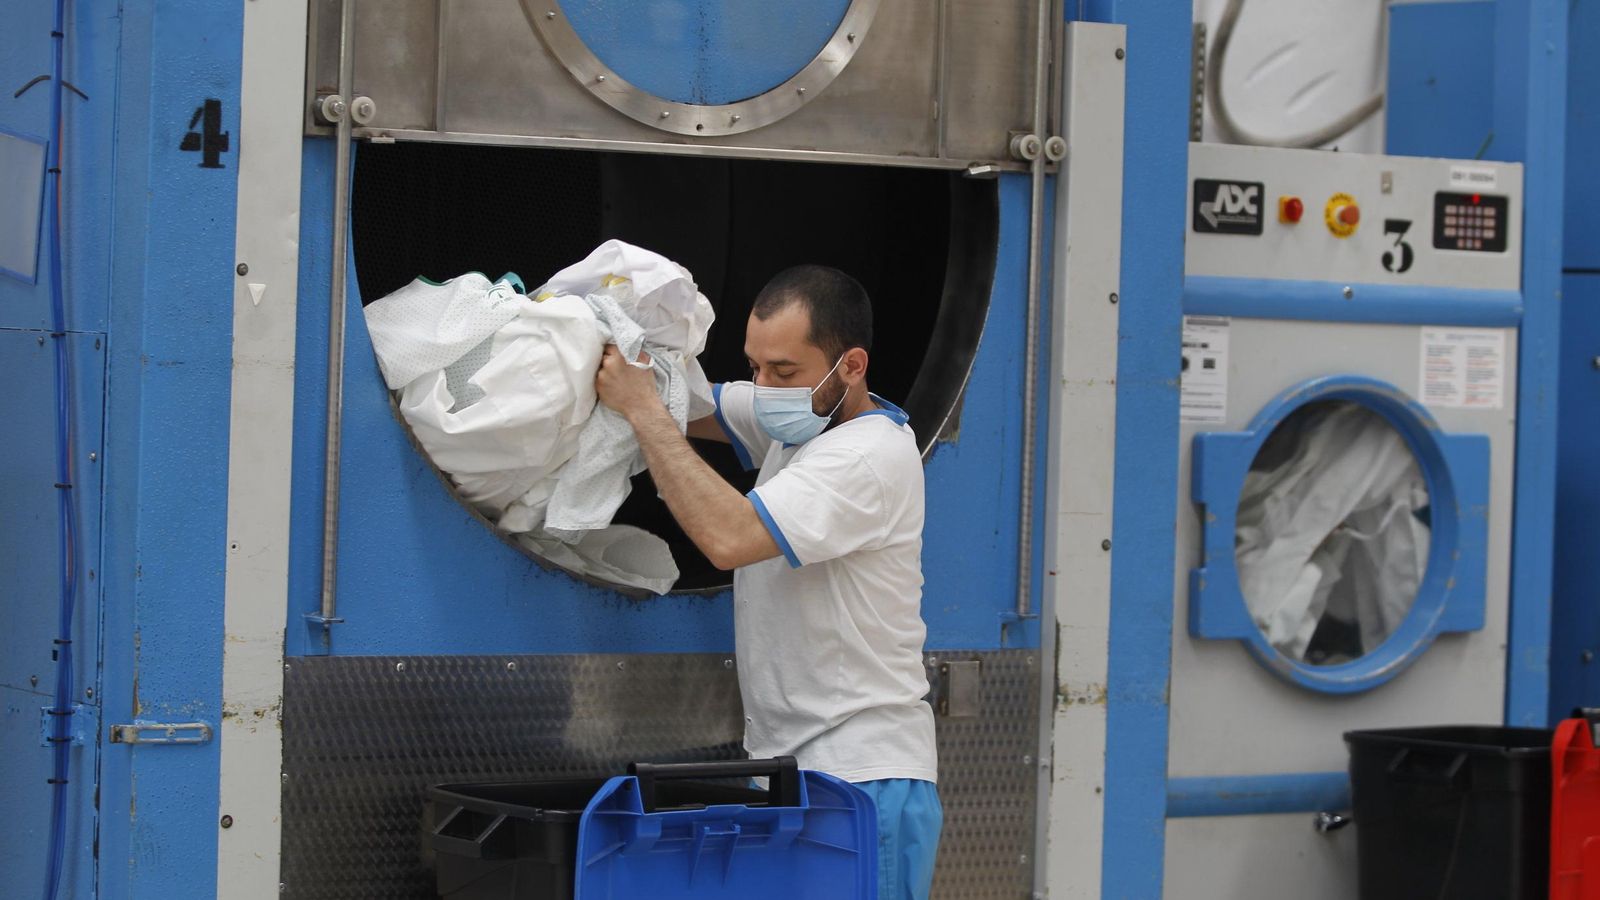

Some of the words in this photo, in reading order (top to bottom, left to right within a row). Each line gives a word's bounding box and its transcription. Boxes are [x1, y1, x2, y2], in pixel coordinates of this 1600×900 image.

[179, 98, 230, 169] 4
[1213, 184, 1258, 215] ADC
[1381, 218, 1414, 273] 3
